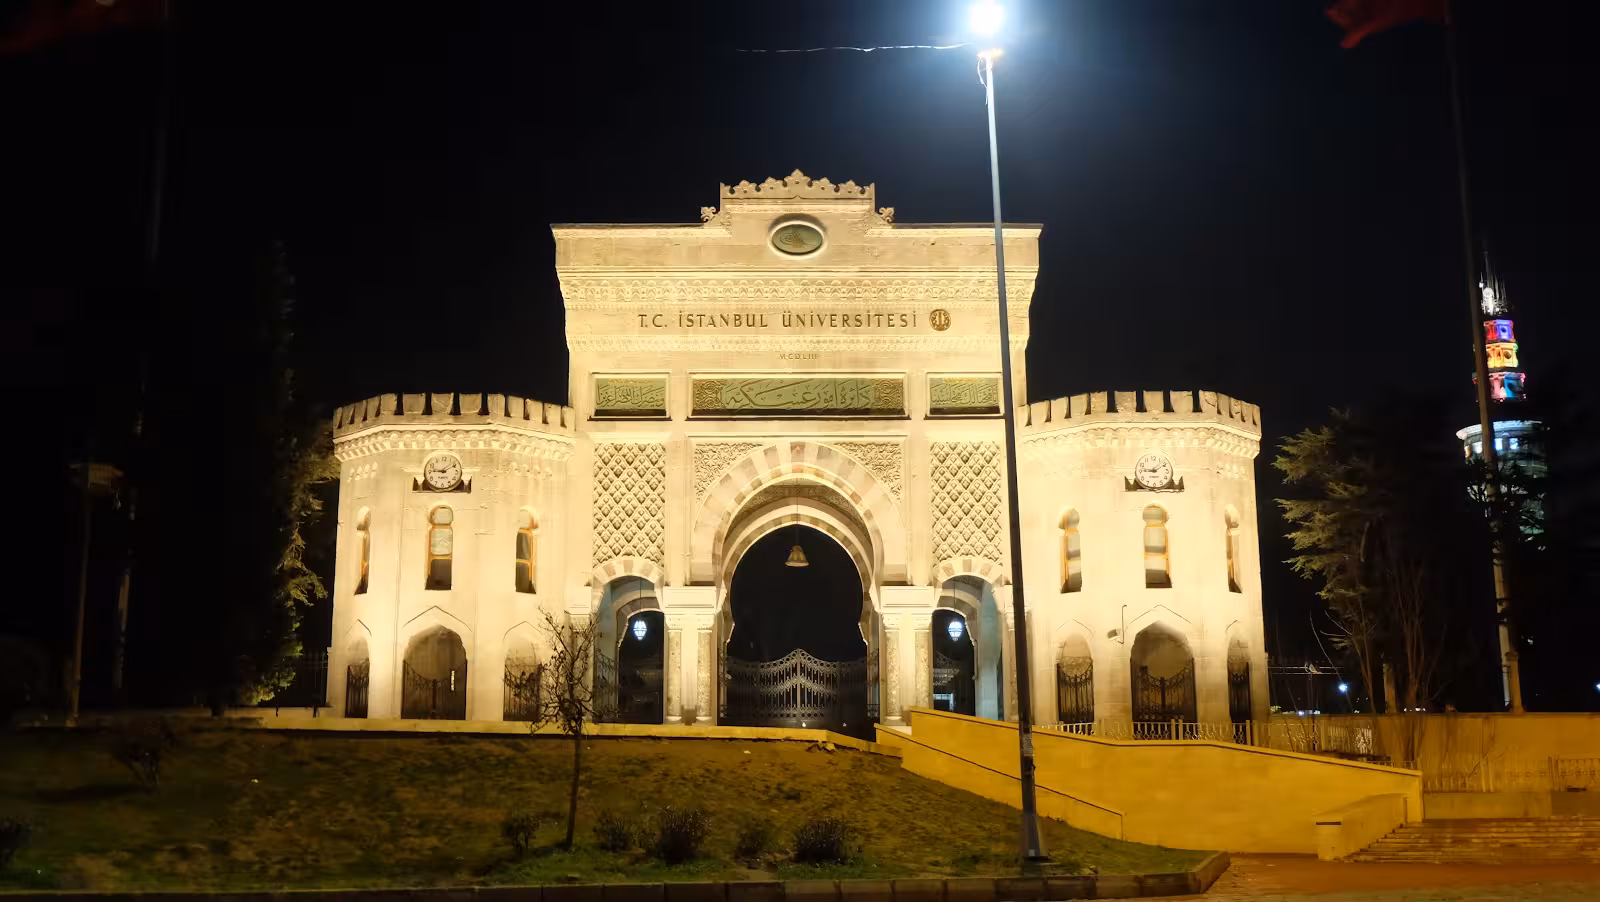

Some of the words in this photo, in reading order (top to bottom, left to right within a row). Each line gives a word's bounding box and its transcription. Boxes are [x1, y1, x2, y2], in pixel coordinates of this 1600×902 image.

[638, 314, 668, 328] T.C.
[678, 311, 768, 328] İSTANBUL
[782, 311, 917, 328] ÜNİVERSİTESİ
